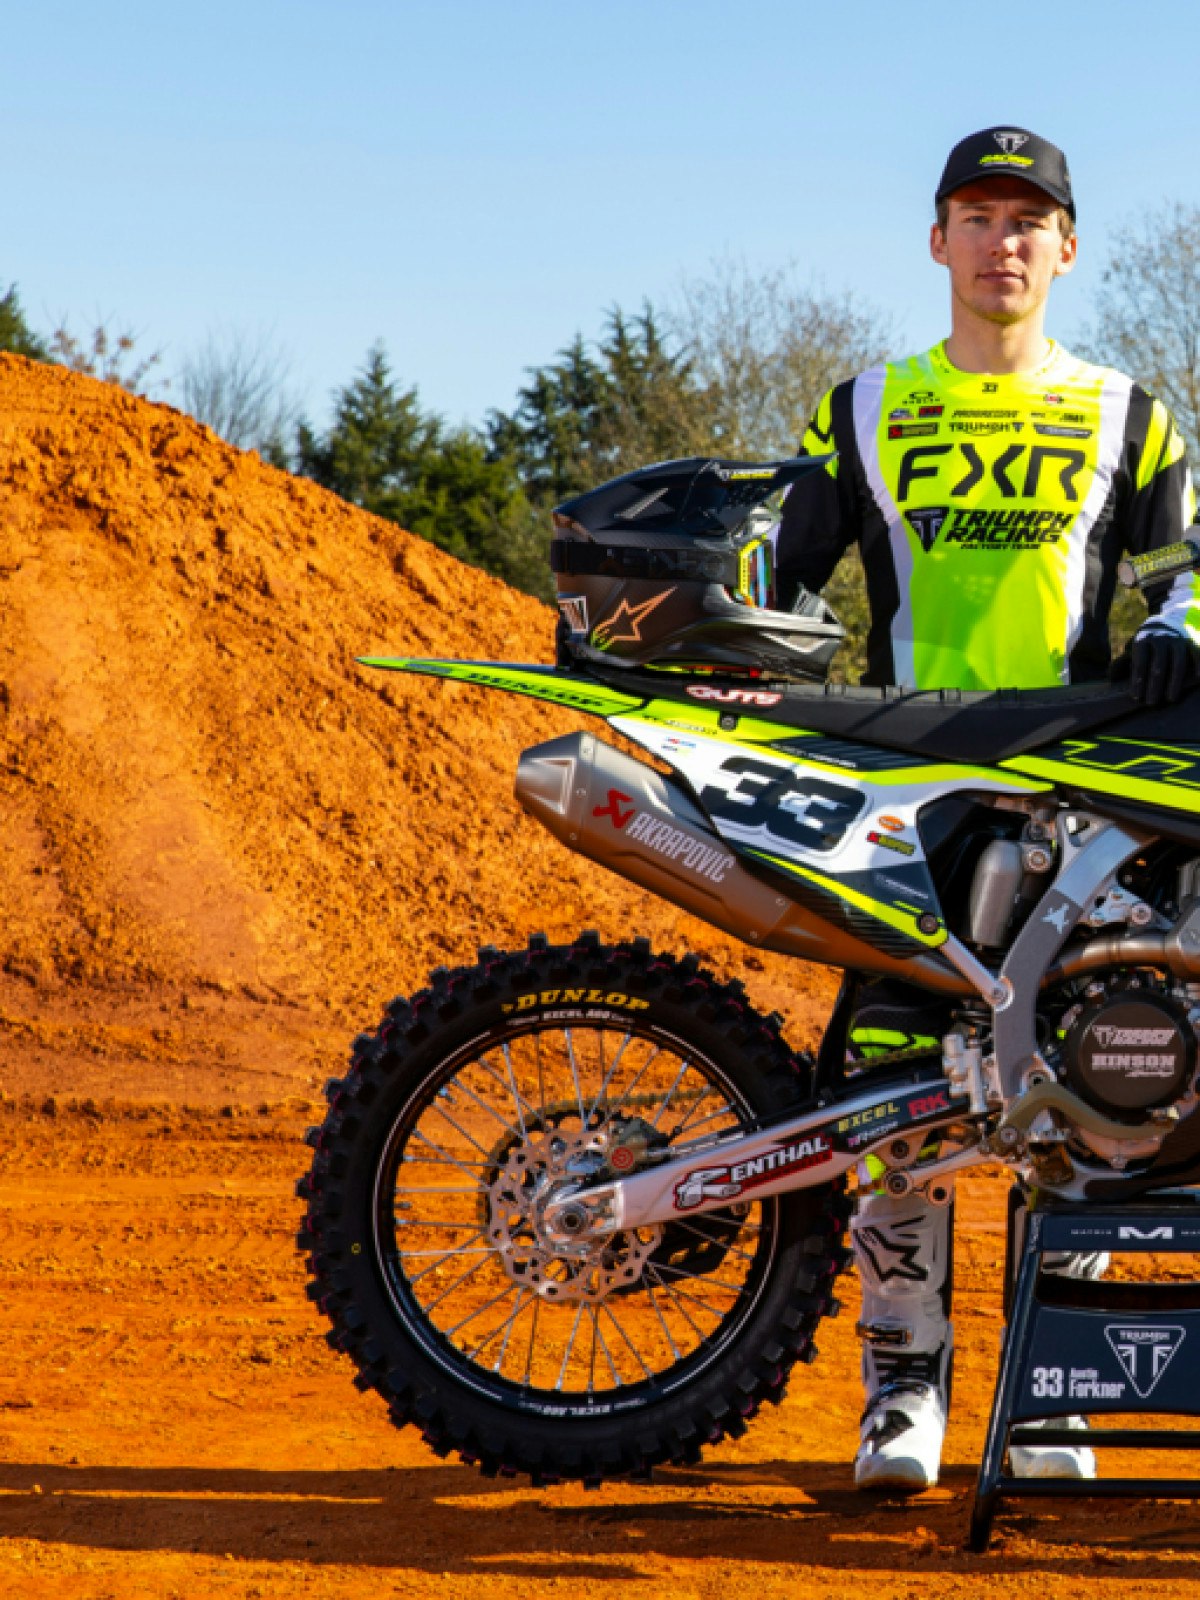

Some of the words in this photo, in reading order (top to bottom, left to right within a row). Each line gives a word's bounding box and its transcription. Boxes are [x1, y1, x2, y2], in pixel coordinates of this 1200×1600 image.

[949, 421, 1010, 434] TRIUMPH
[897, 442, 1086, 502] FXR
[952, 509, 1074, 528] TRIUMPH
[944, 527, 1063, 544] RACING
[699, 755, 866, 852] 33
[515, 989, 650, 1011] DUNLOP
[908, 1090, 950, 1117] RK
[838, 1101, 899, 1133] EXCEL
[1119, 1329, 1170, 1344] TRIUMPH
[1032, 1367, 1064, 1398] 33
